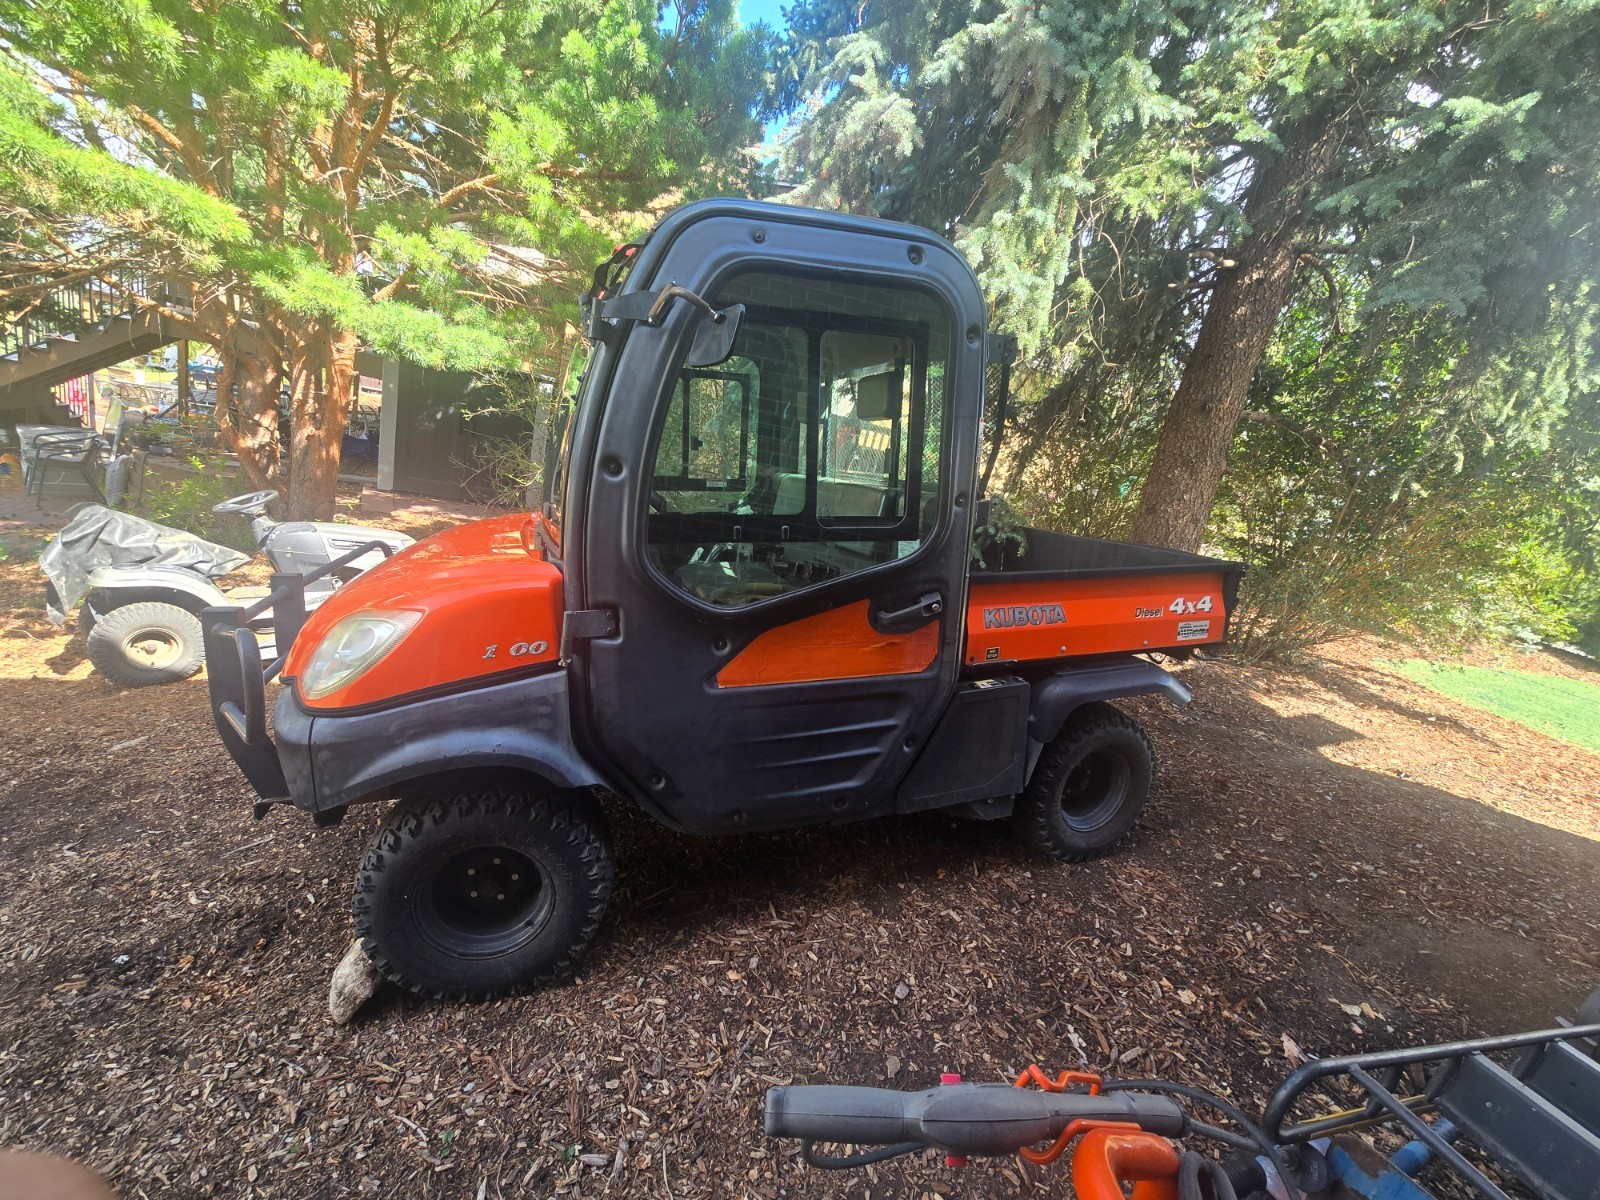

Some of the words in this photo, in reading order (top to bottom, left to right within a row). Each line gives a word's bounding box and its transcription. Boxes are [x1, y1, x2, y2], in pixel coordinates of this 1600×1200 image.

[983, 604, 1067, 629] KUBOTA
[1134, 607, 1164, 619] Diesel
[1169, 595, 1213, 615] 4x4
